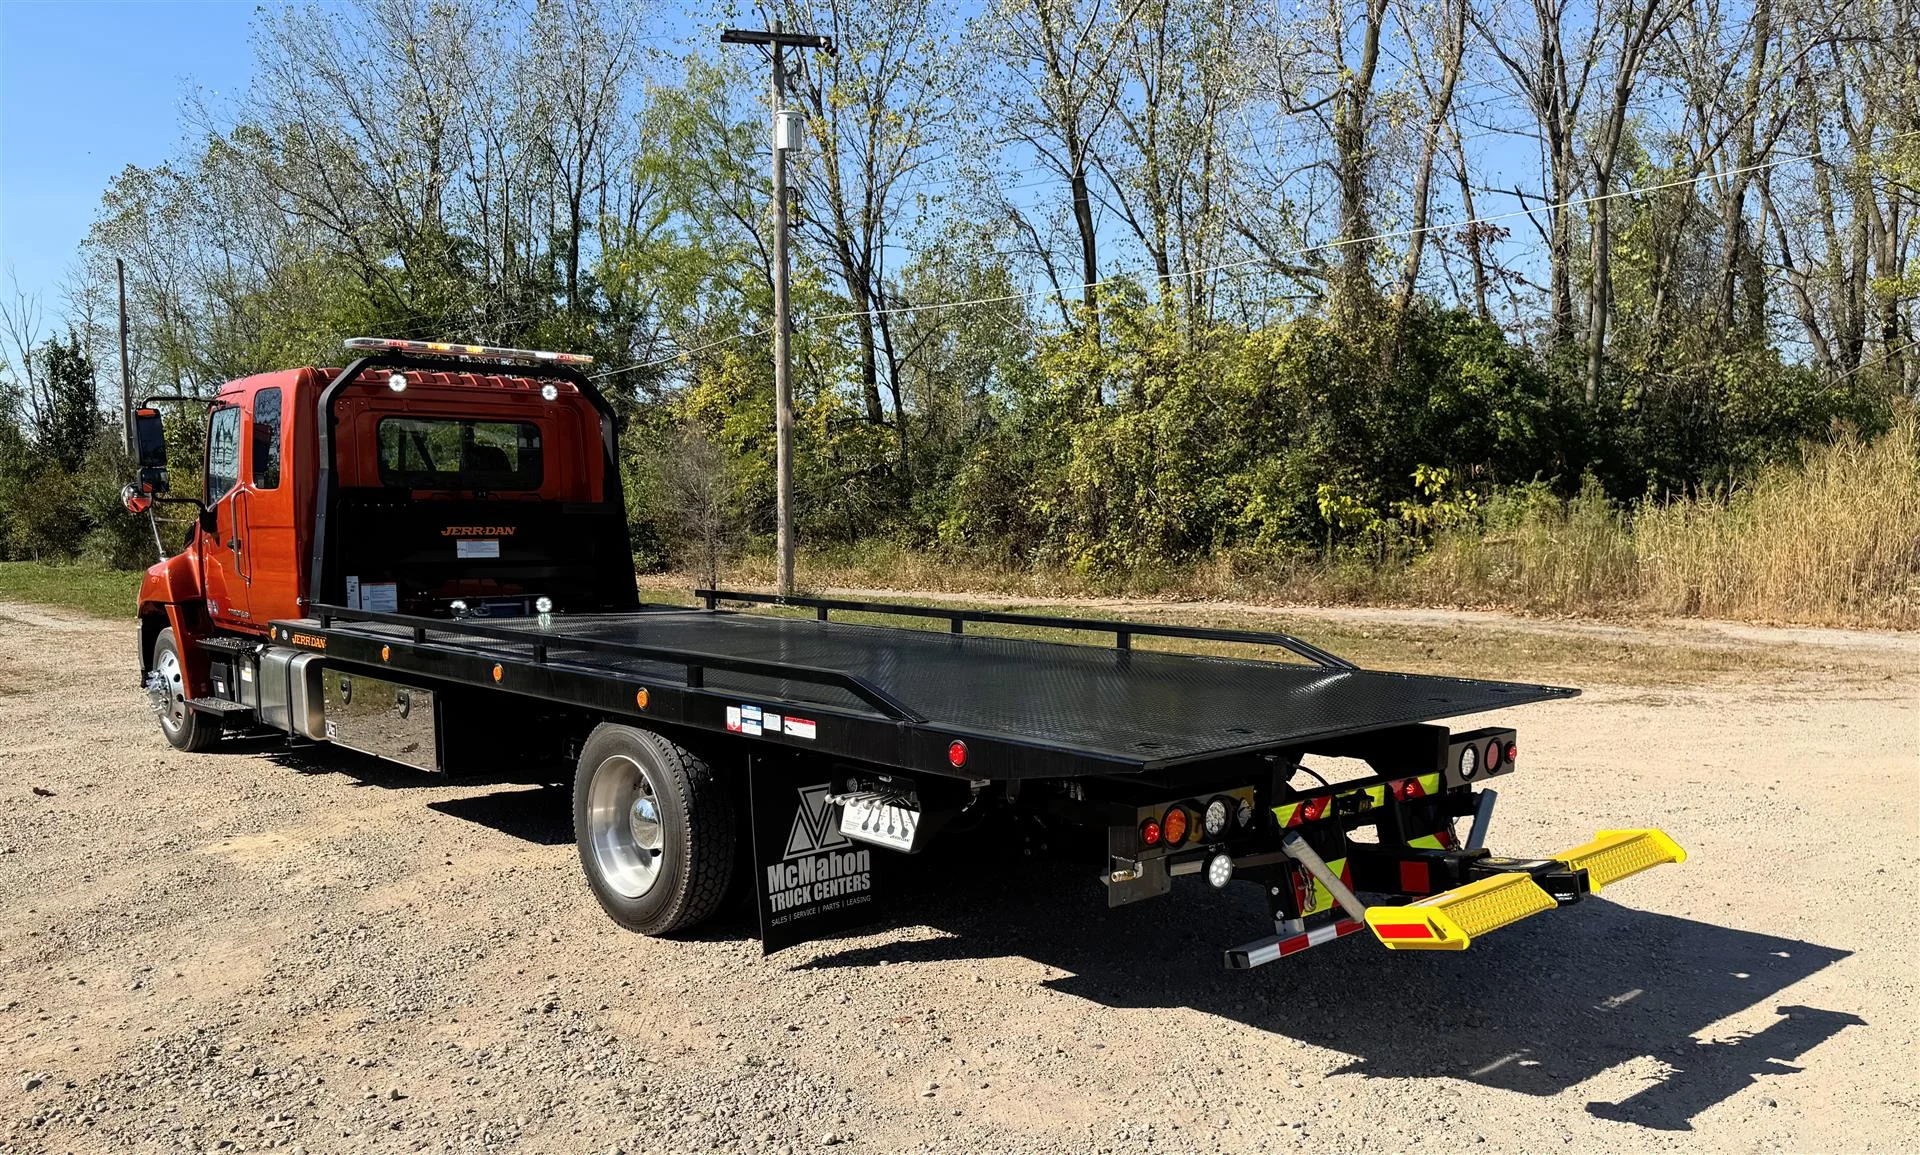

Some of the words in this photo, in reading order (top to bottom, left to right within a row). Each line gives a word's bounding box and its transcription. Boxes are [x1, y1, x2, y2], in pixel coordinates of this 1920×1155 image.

[441, 526, 516, 536] JERR-DAN
[767, 850, 871, 894] McMahon
[769, 885, 812, 913] TRUCK
[813, 873, 871, 901] CENTERS
[771, 916, 787, 926] SALES
[793, 907, 816, 919] SERVICE
[822, 901, 840, 912] PARTS
[846, 895, 871, 906] LEASING
